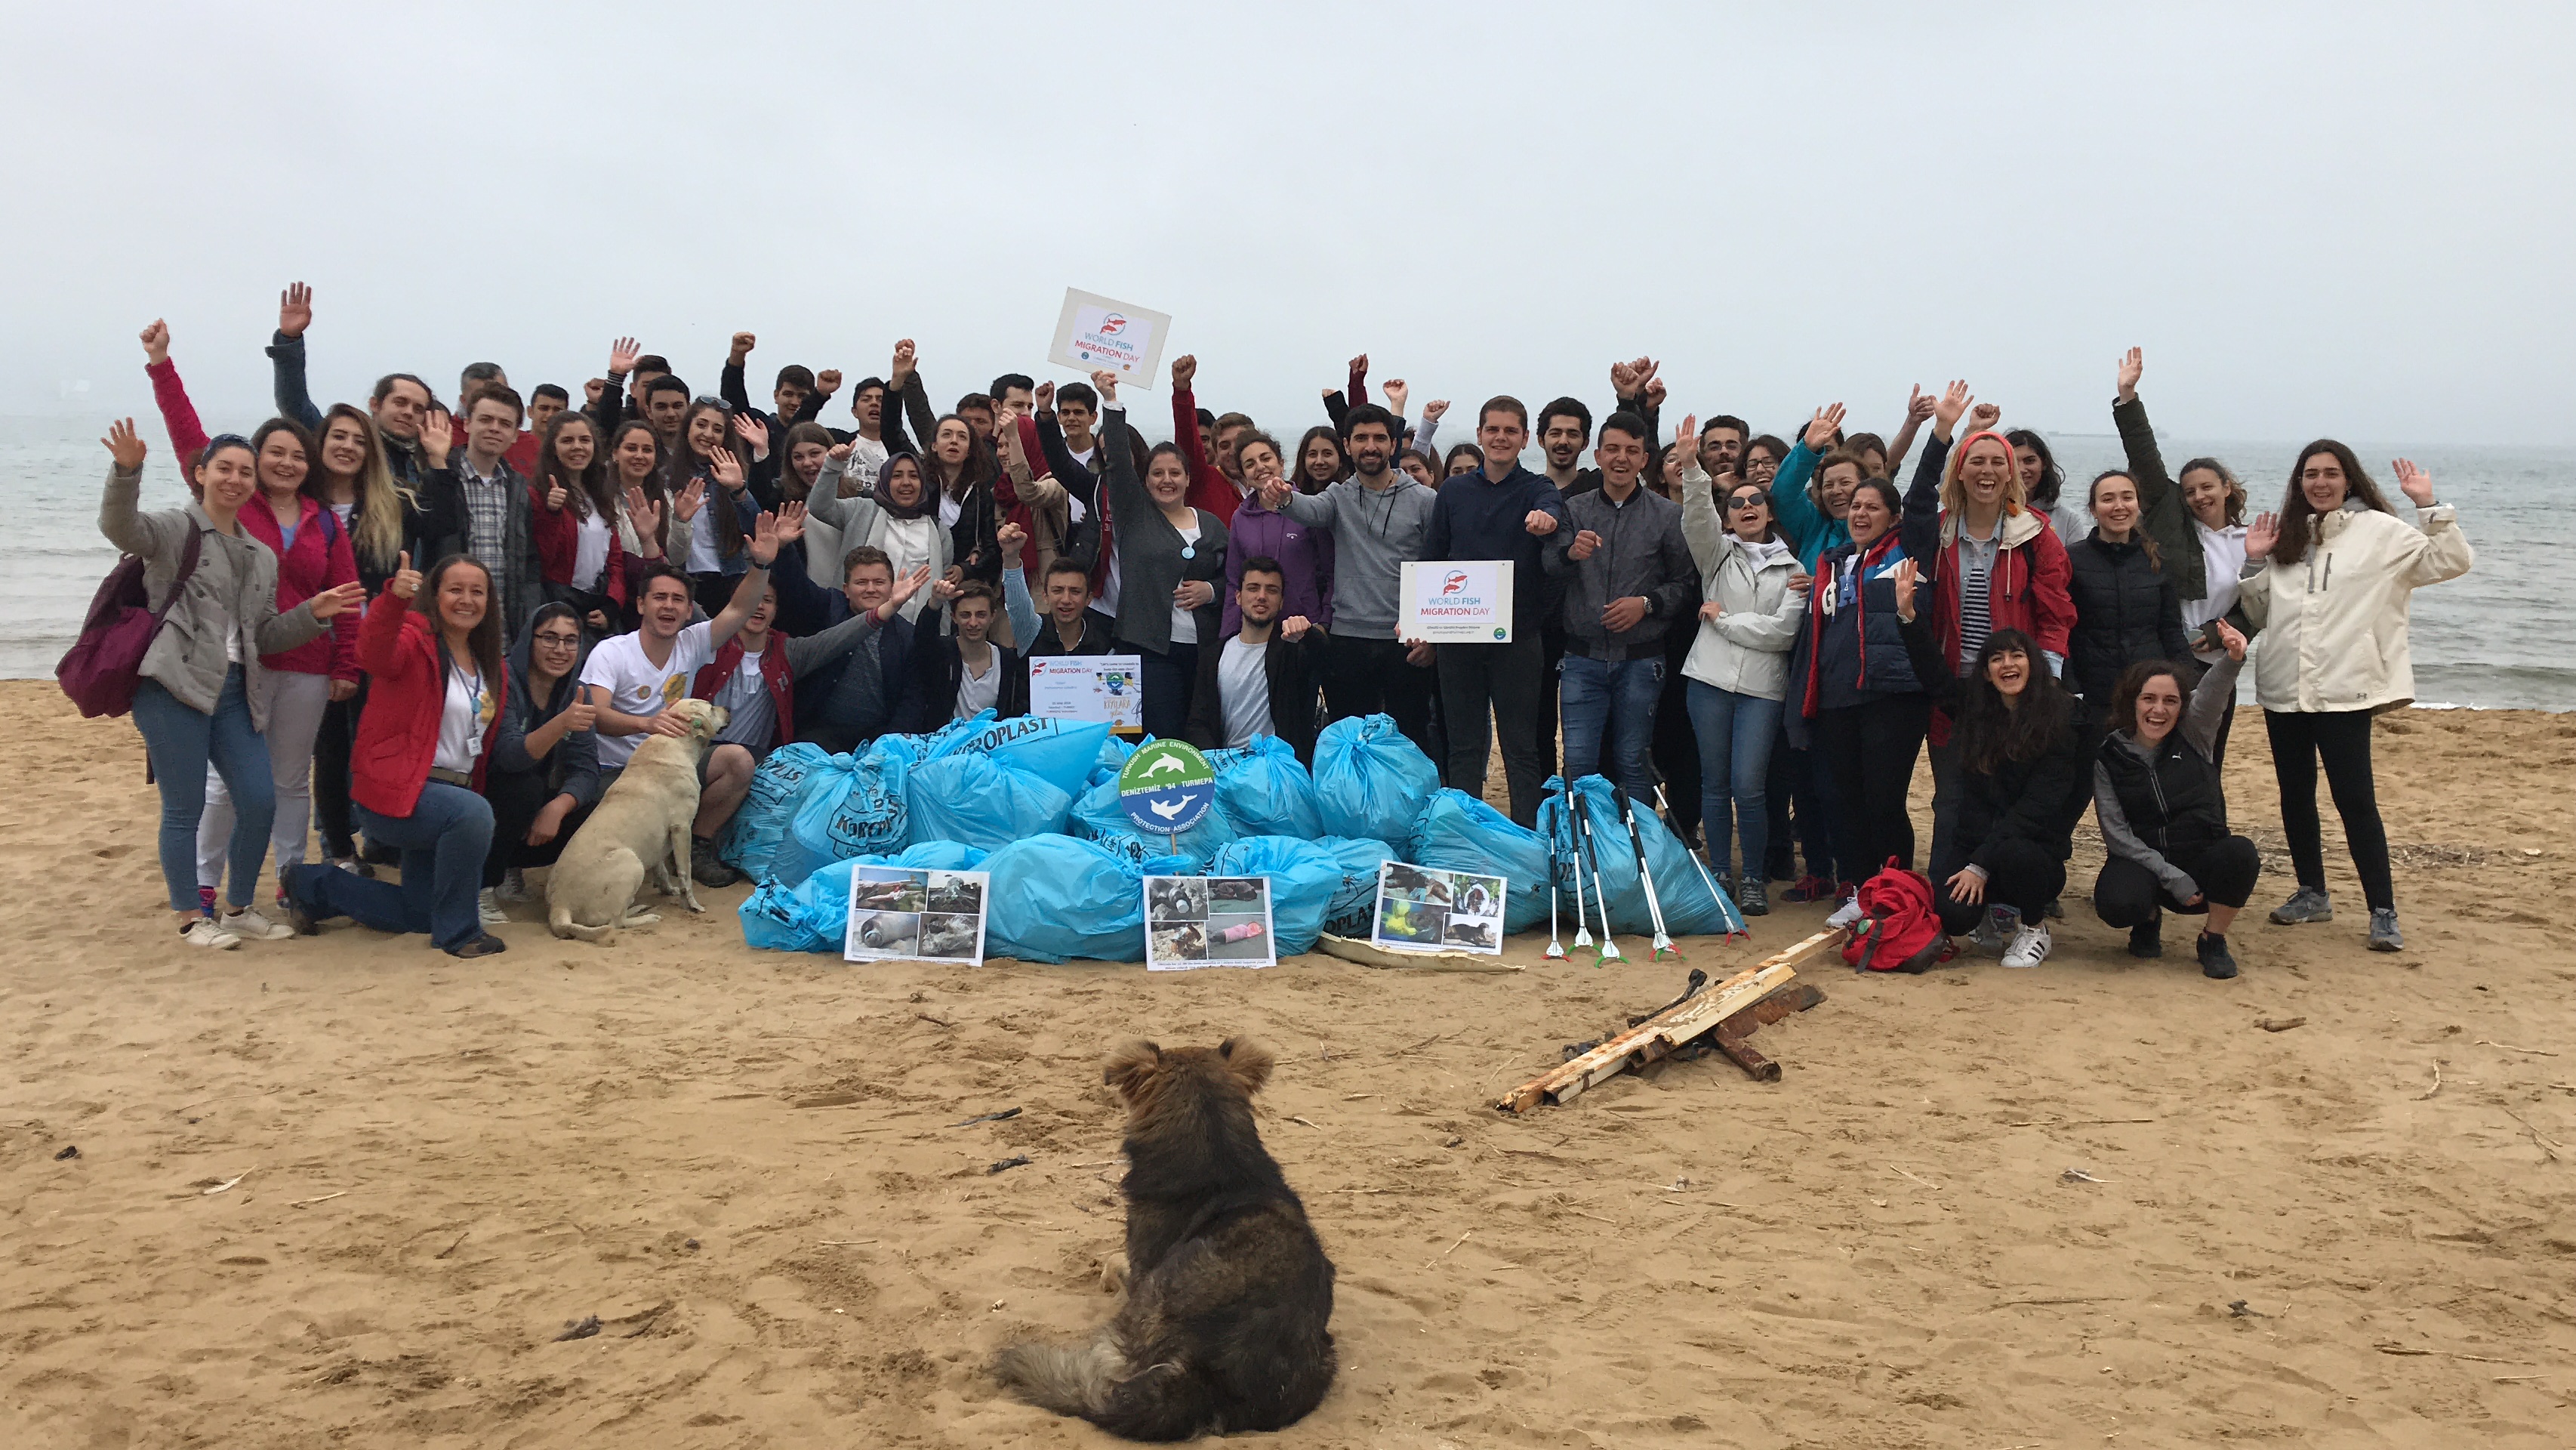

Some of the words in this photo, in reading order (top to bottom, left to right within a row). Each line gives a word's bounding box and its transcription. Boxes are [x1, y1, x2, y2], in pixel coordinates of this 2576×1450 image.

[1074, 340, 1123, 359] MIGRATION
[1123, 353, 1141, 363] DAY
[1085, 332, 1114, 346] WORLD
[1115, 341, 1134, 352] FISH
[1420, 607, 1471, 615] MIGRATION
[1472, 607, 1490, 615] DAY
[1122, 754, 1141, 779] TURKISH
[1141, 742, 1166, 755] MARINE
[1169, 742, 1209, 770] ENVIRONMENT
[1181, 777, 1213, 788] TURMEPA
[1130, 812, 1170, 832] PROTECTION
[1172, 802, 1209, 831] ASSOCIATION
